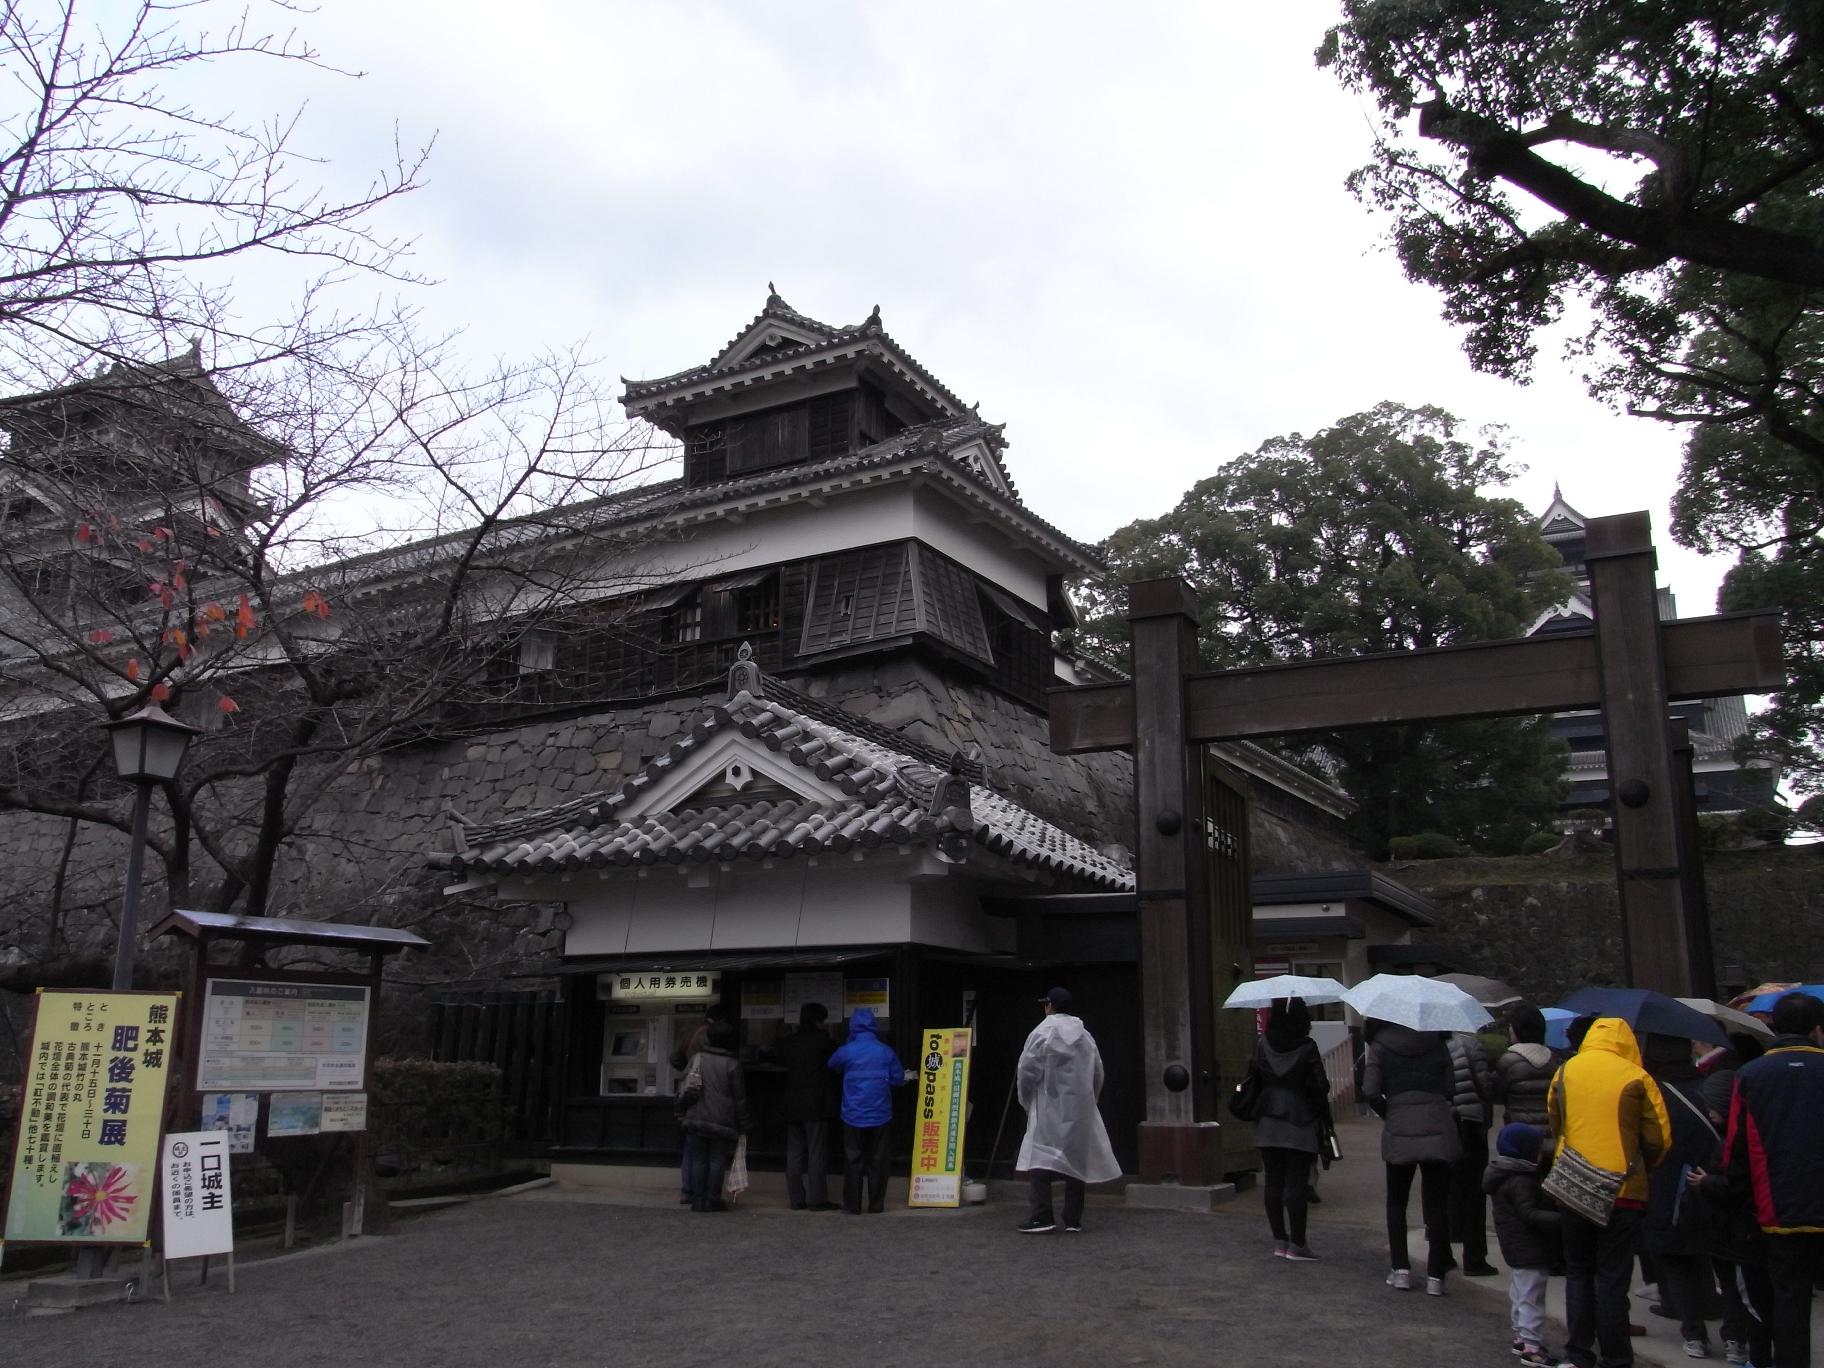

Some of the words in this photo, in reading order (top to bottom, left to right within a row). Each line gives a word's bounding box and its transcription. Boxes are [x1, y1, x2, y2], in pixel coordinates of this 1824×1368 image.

[619, 975, 708, 990] 個人用券売機
[83, 1002, 95, 1032] ところ
[142, 1004, 169, 1068] 熊本城
[72, 1042, 90, 1102] 熊本城竹の丸
[98, 1025, 140, 1146] 肥後菊展
[200, 1140, 223, 1210] 一口城主
[920, 1121, 941, 1171] 販売中
